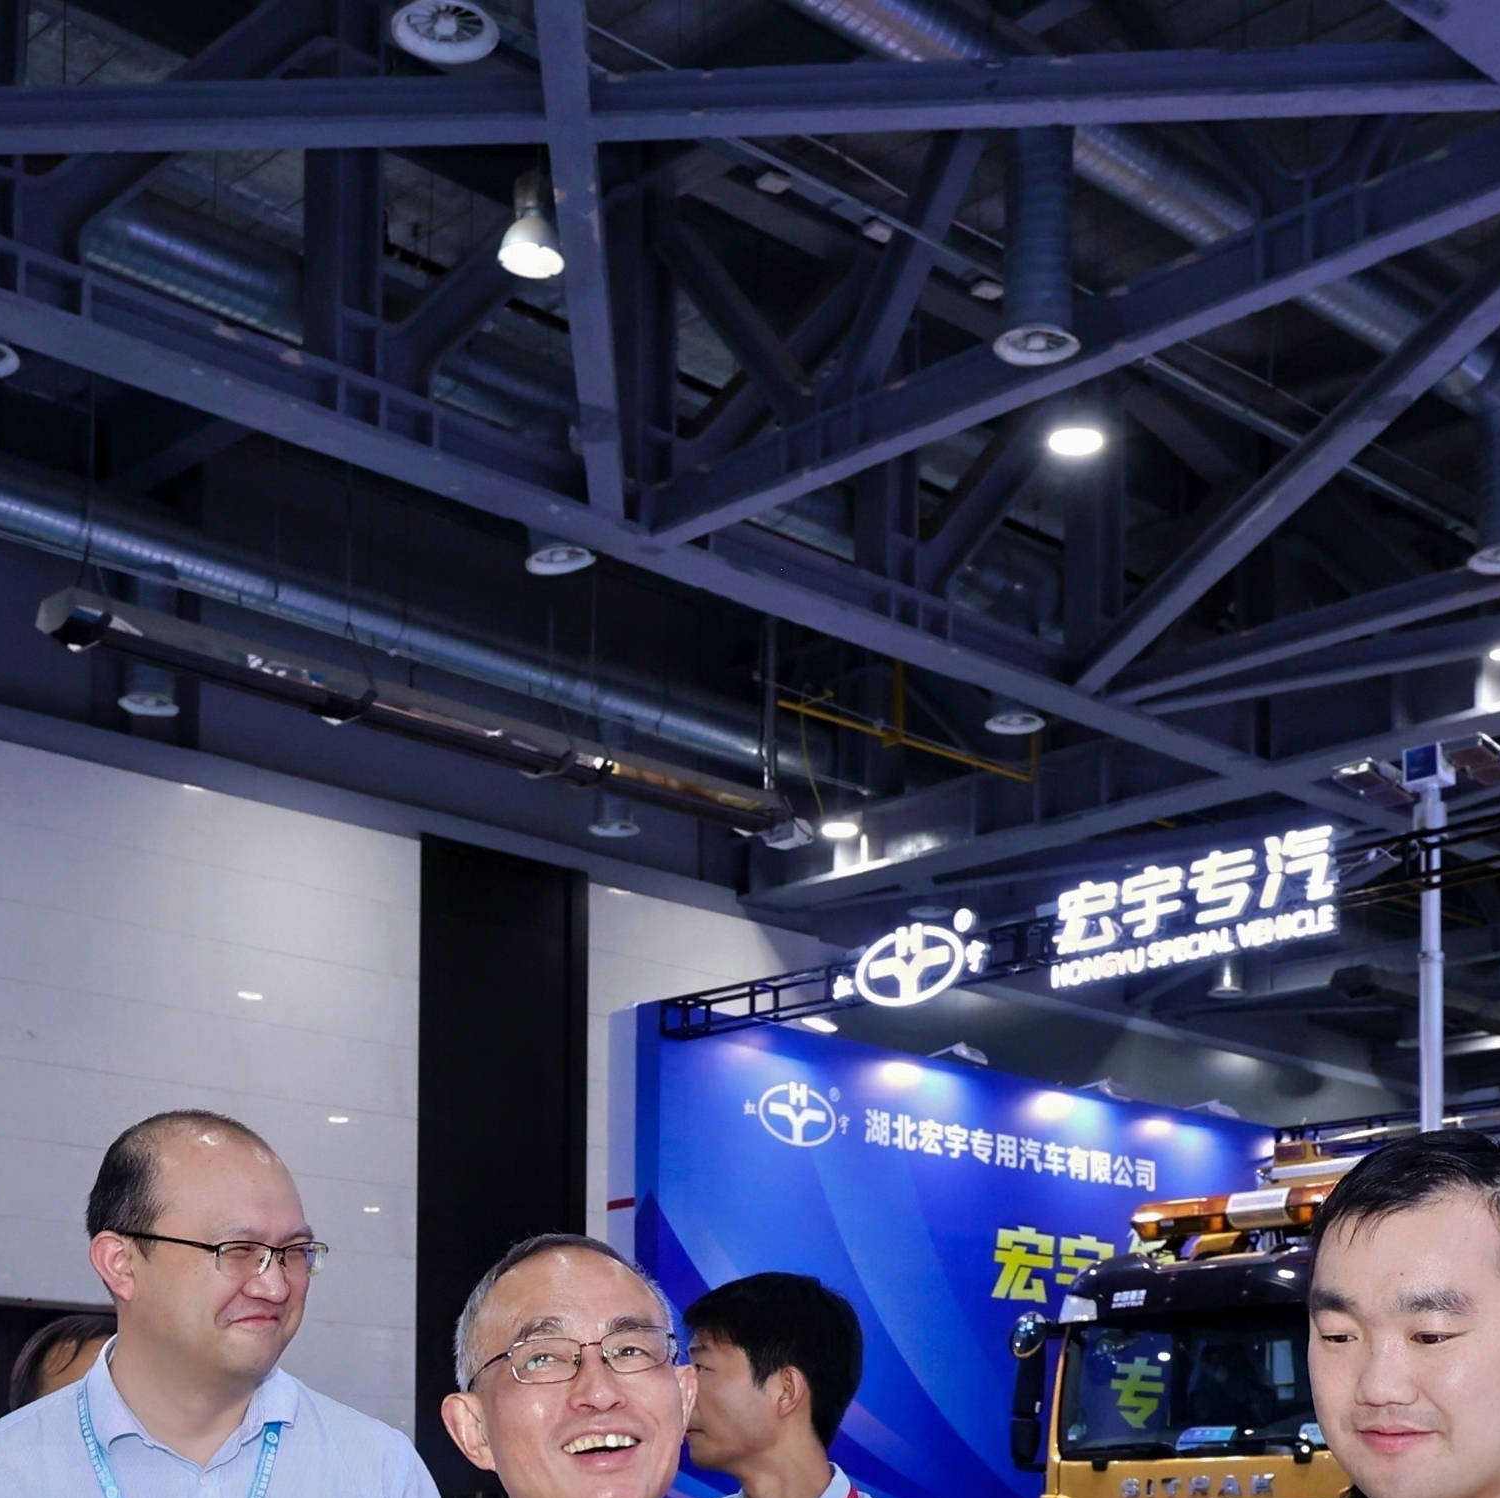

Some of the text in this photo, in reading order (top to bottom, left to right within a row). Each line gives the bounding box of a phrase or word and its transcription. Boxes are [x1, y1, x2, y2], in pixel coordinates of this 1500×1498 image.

[1052, 825, 1333, 955] 宏宇专汽
[1051, 904, 1335, 989] HONGYU SPECIAL VEHICLE
[864, 1109, 1157, 1192] 湖北宏宇专用汽车有限公司
[1121, 1473, 1276, 1498] SITRAK
